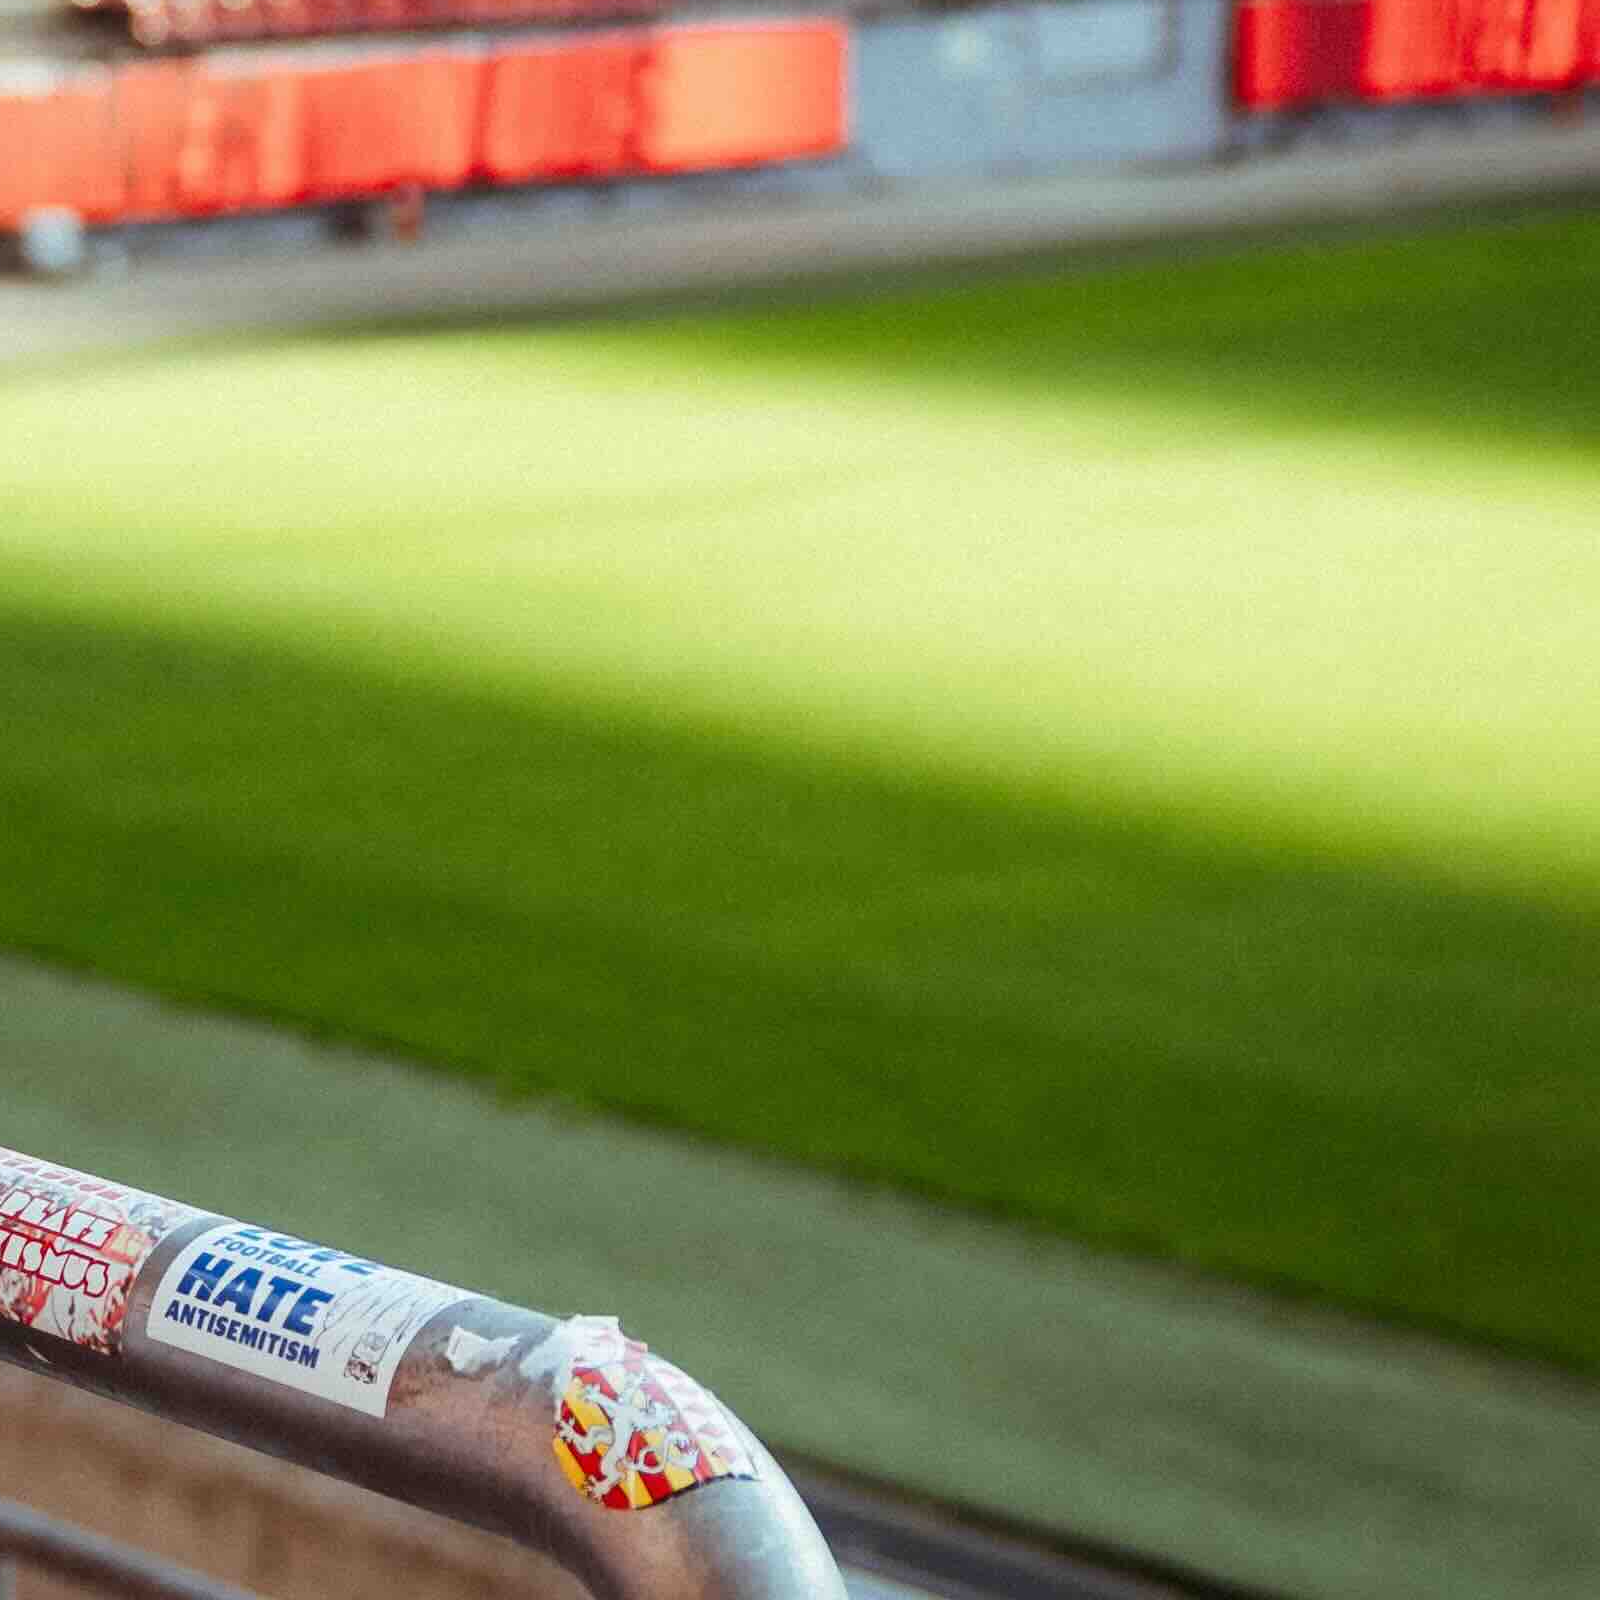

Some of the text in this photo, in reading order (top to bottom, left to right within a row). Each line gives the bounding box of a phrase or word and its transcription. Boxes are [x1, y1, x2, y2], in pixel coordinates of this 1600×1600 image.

[213, 1236, 323, 1278] FOOTBALL
[175, 1251, 335, 1337] HATE
[164, 1300, 321, 1370] ANTISEMITISM
